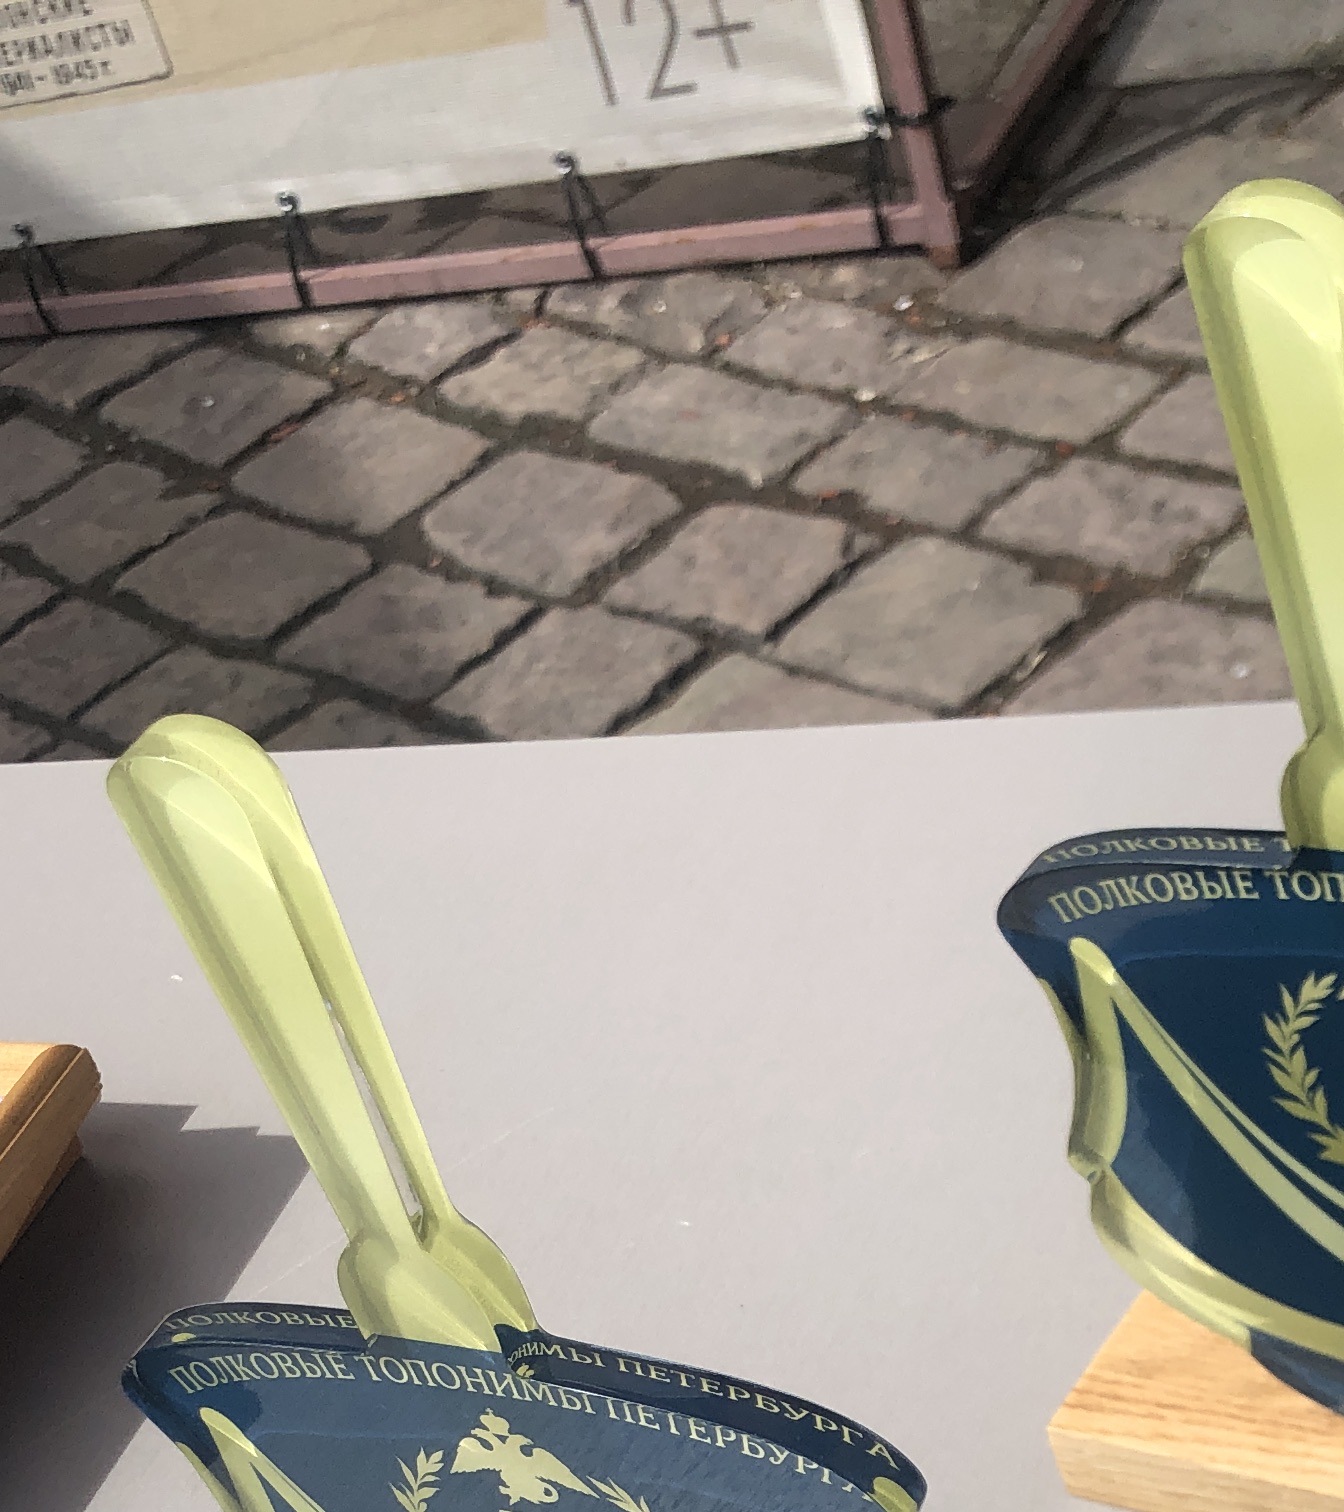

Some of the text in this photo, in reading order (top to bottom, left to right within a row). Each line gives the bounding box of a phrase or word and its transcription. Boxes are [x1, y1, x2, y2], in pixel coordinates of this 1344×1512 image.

[567, 0, 755, 106] 12+
[1047, 870, 1260, 924] ПОЛКОВЫЕ
[164, 1311, 358, 1330] ПОЛКОВЫЕ
[616, 1356, 901, 1471] ПЕТЕРБУРГА
[169, 1352, 873, 1502] ПОЛКОВЫЕ ТОПОНИМЫ ПЕТЕРБУРГ
